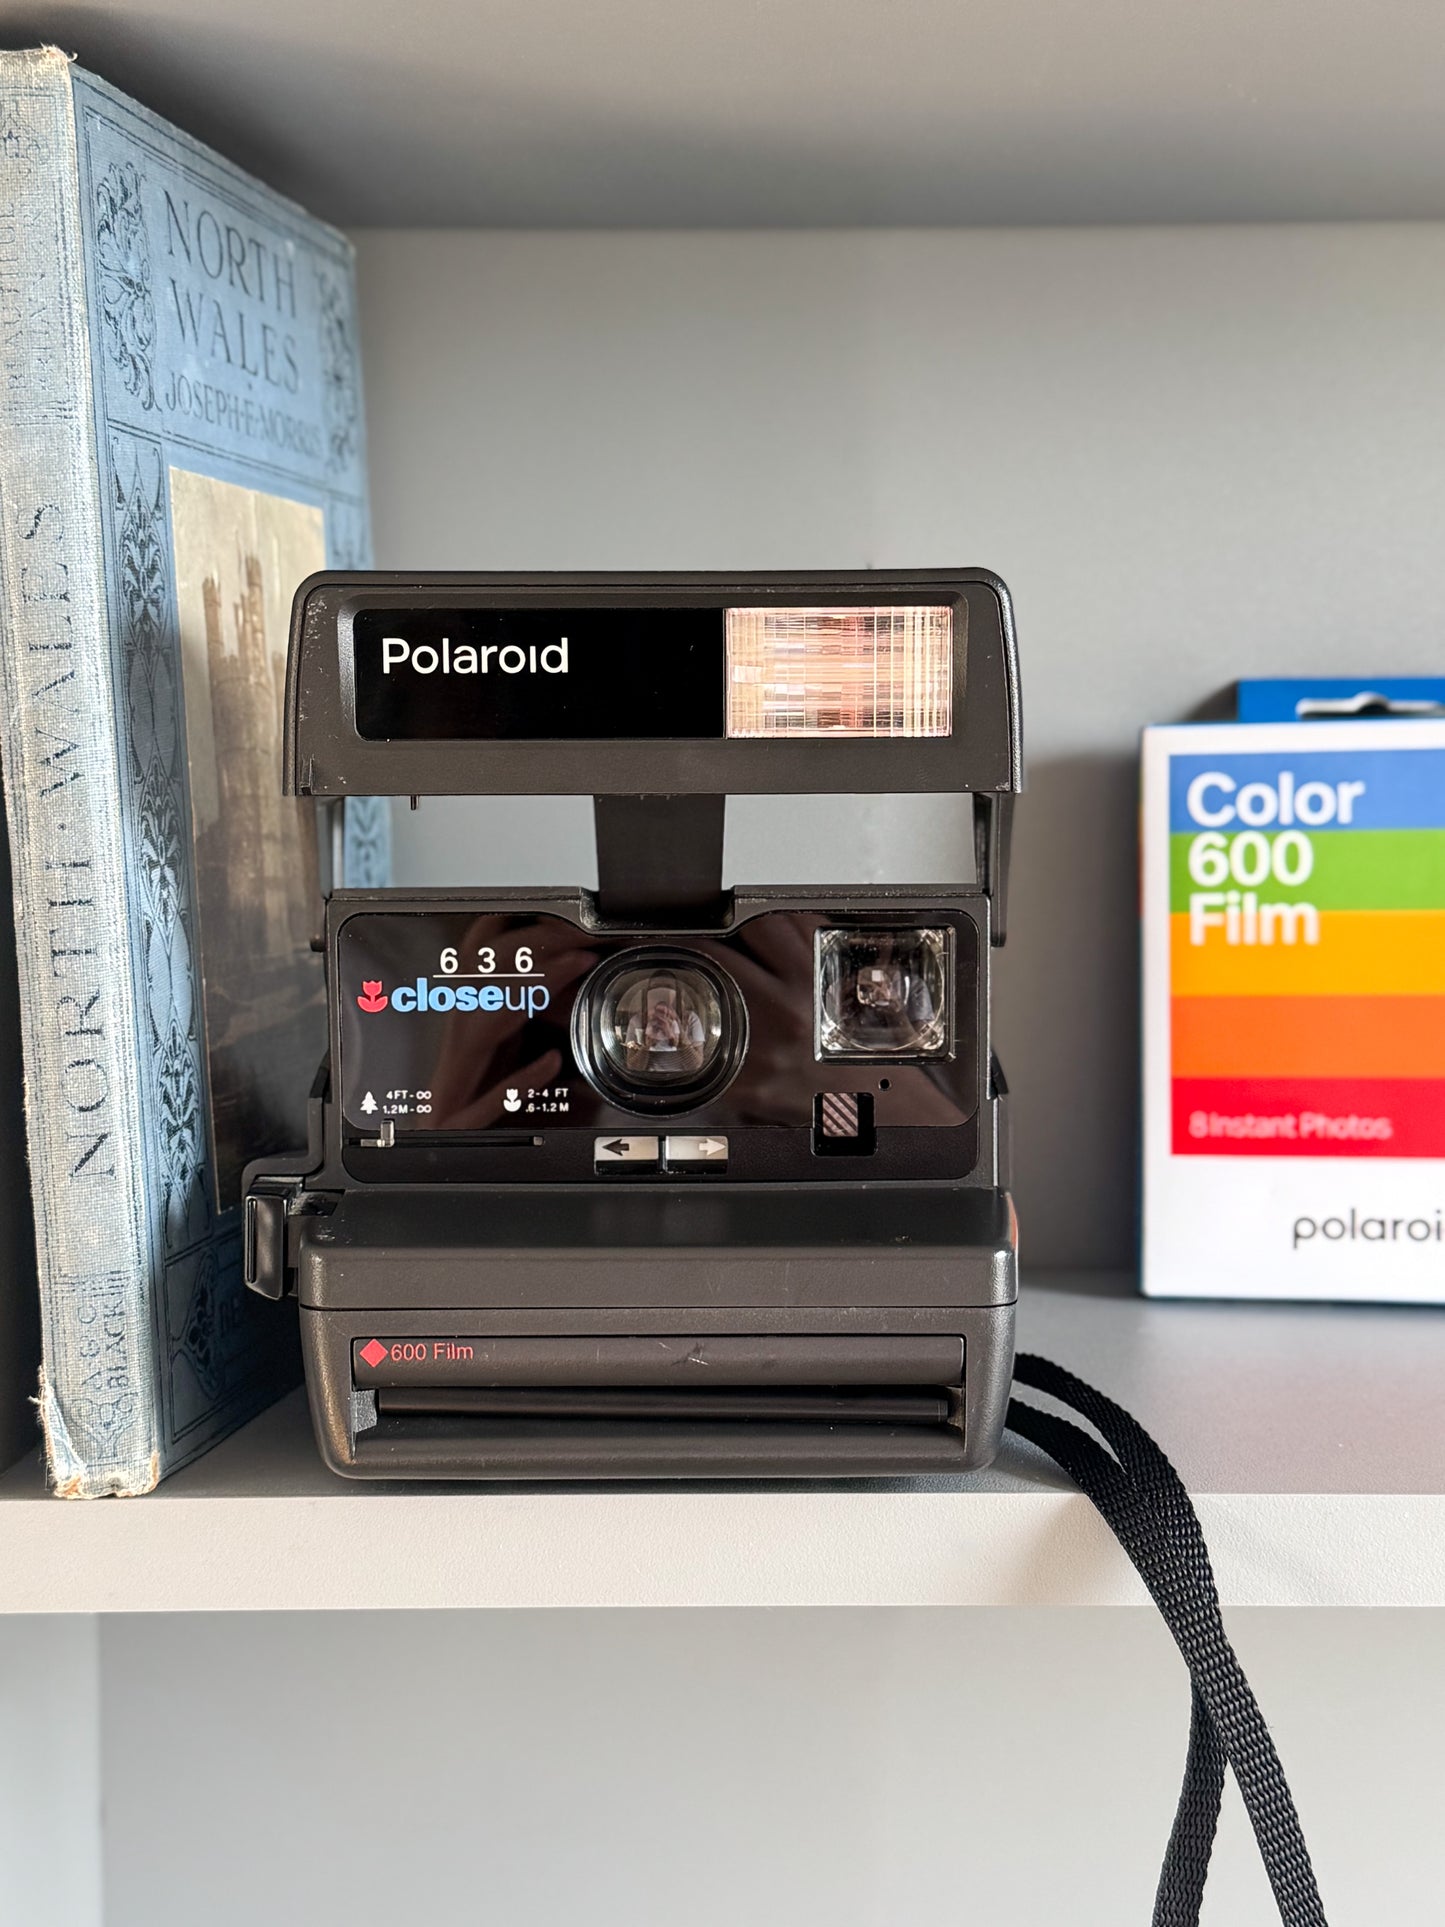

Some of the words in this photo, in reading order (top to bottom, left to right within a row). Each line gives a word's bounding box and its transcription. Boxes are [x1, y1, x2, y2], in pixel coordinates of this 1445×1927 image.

[164, 189, 297, 319] NORTH
[169, 276, 300, 394] WALES
[16, 503, 86, 797] WALES
[383, 637, 569, 674] Polaroid
[1186, 771, 1366, 828] Color
[1188, 829, 1314, 887] 600
[1189, 889, 1320, 946] Film
[45, 857, 117, 1181] NORTH
[391, 977, 550, 1018] closeup
[554, 1088, 569, 1098] FT
[1188, 1110, 1209, 1139] 8
[1209, 1111, 1298, 1139] Instant
[1300, 1111, 1394, 1140] Photos
[391, 1343, 427, 1361] 600
[433, 1342, 474, 1361] Film
